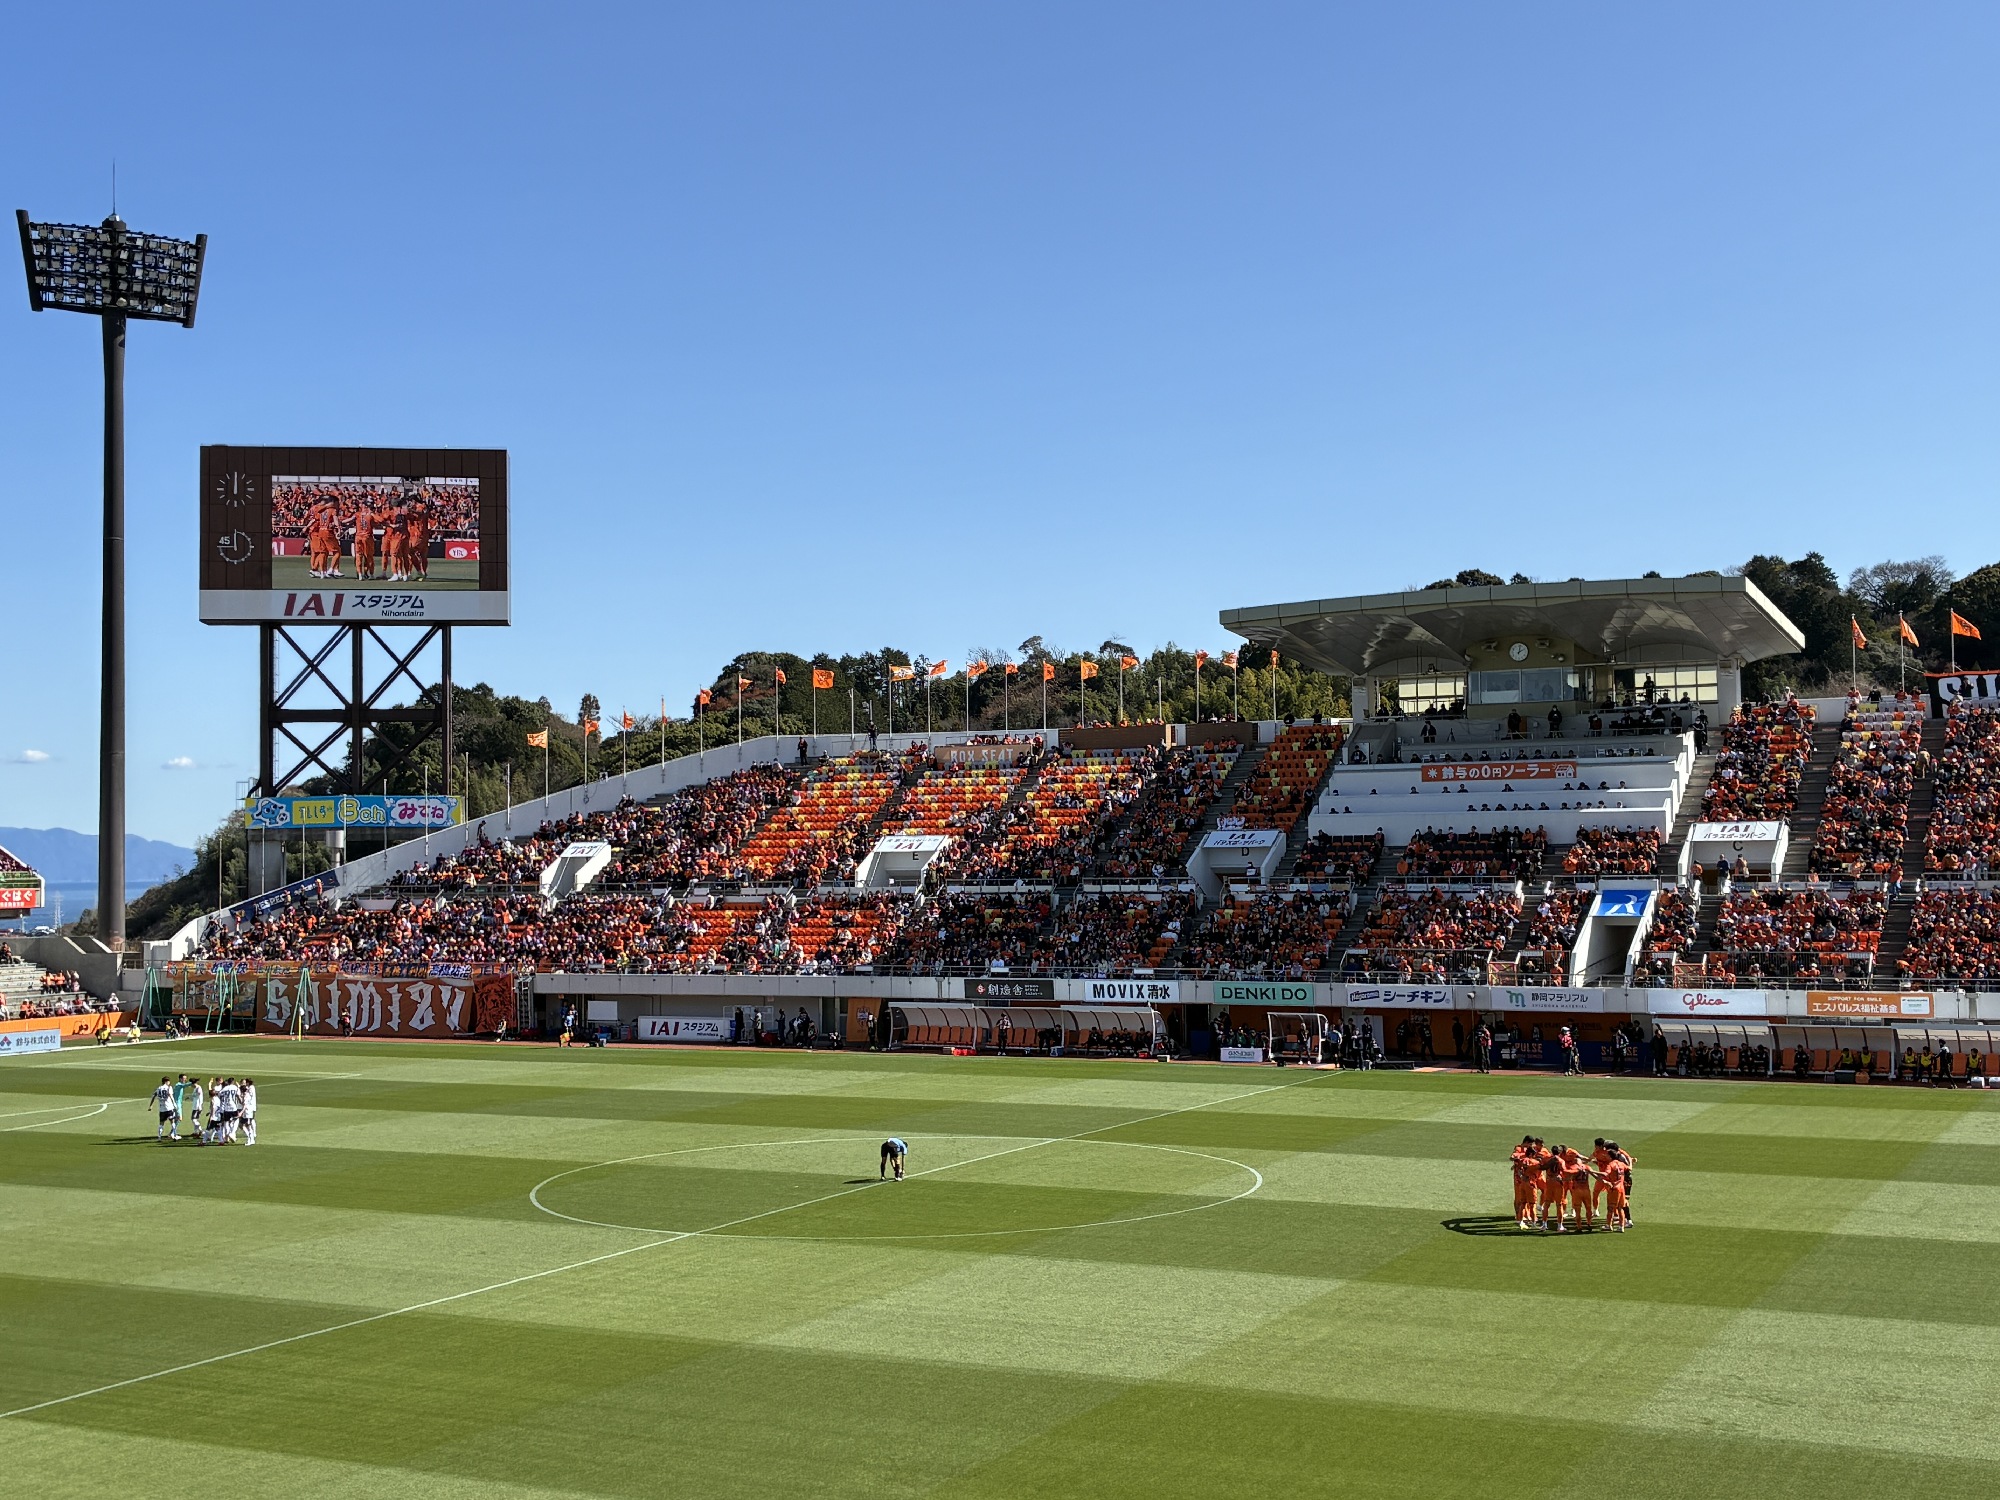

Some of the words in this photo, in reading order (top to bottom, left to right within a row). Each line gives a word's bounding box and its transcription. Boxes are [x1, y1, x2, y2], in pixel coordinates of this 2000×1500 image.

[219, 536, 230, 545] 45
[284, 593, 345, 616] IAI
[352, 595, 425, 609] スタジアム
[381, 609, 425, 617] Nihondaira
[950, 749, 975, 763] BOX
[981, 748, 1014, 762] SEAT
[1441, 763, 1551, 780] 鈴与の0円ソーラー
[339, 798, 386, 824] 8ch
[397, 802, 444, 819] みてね
[1720, 824, 1751, 833] IAI
[893, 842, 924, 850] IAI
[1241, 847, 1250, 856] D
[1732, 841, 1744, 851] C
[912, 852, 920, 861] E
[1092, 984, 1145, 999] MOVIX
[1147, 984, 1171, 1000] 清水
[1221, 987, 1277, 1000] DENKI
[1281, 988, 1308, 1001] DO
[1383, 990, 1447, 1003] シーチキン
[1531, 992, 1589, 1003] 静岡マテリアル
[262, 978, 466, 1031] SHIMIZU
[1682, 993, 1730, 1011] Glico
[1812, 1002, 1898, 1013] エスパルス福祉基金
[650, 1021, 680, 1036] IAI
[682, 1022, 719, 1032] スタジアム
